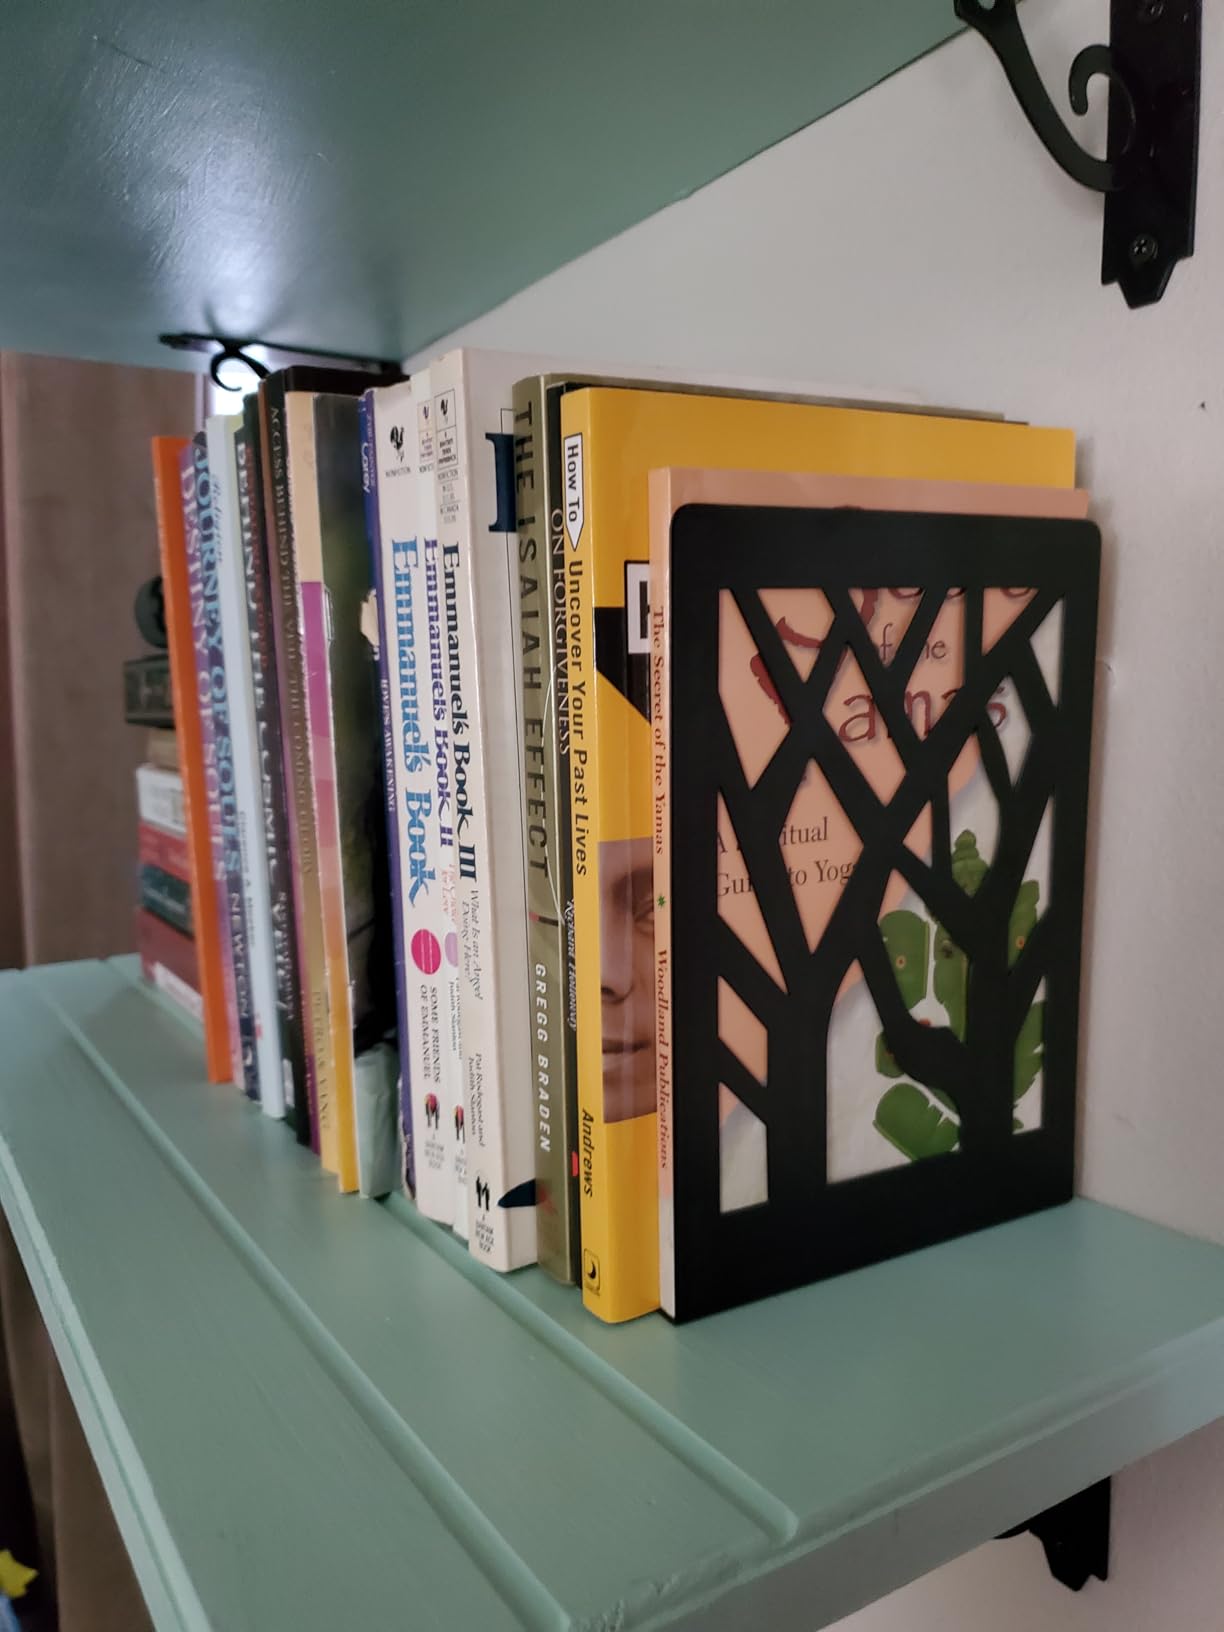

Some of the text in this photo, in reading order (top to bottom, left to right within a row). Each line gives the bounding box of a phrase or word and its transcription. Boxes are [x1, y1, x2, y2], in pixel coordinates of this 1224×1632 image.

[181, 466, 209, 654] DESTINY
[567, 444, 580, 522] How To
[194, 447, 240, 870] JOURNEY OF SOULS
[392, 536, 436, 908] Emmanuel's Book
[424, 537, 453, 847] Emmanuel's Book II
[443, 541, 470, 735] Emmanuel's
[515, 401, 549, 878] THE ISAIAH EFFECT
[551, 508, 571, 755] ON FORGIVENESS
[569, 560, 589, 876] Uncover Your Past Lives
[453, 742, 474, 841] Book
[653, 605, 667, 855] The Secret of the Yamas
[458, 843, 477, 882] III
[470, 890, 480, 924] What
[420, 985, 431, 1079] OF EMMANUEL
[430, 986, 441, 1083] SOME FRIENDS
[535, 963, 550, 1152] GREGG BRADEN
[657, 949, 671, 1169] Woodland Publications
[582, 1108, 594, 1197] Andrews
